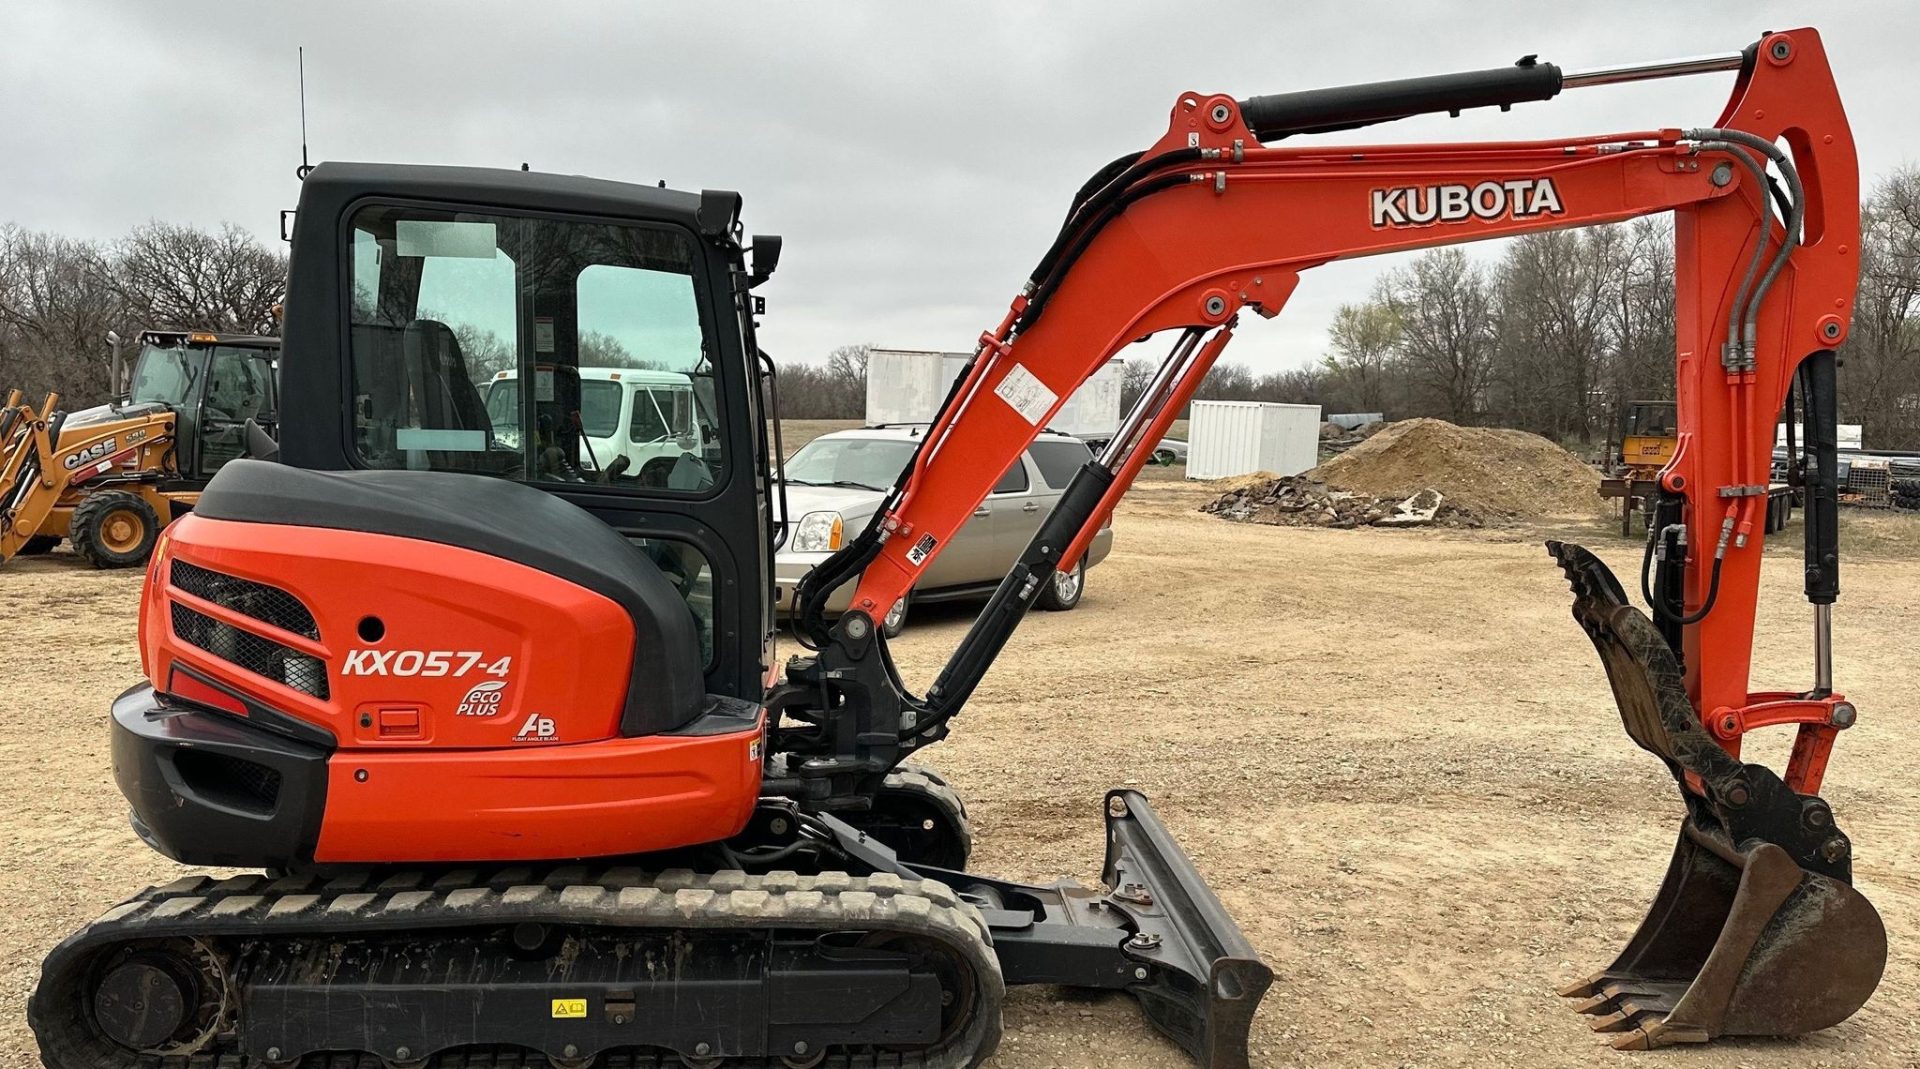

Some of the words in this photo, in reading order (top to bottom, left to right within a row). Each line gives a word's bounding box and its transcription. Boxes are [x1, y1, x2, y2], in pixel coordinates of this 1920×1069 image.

[1372, 178, 1562, 226] KUBOTA
[64, 436, 117, 470] CASE
[341, 650, 512, 677] KX057-4
[456, 703, 499, 716] PLUS
[470, 691, 502, 703] eco
[517, 713, 556, 737] AB
